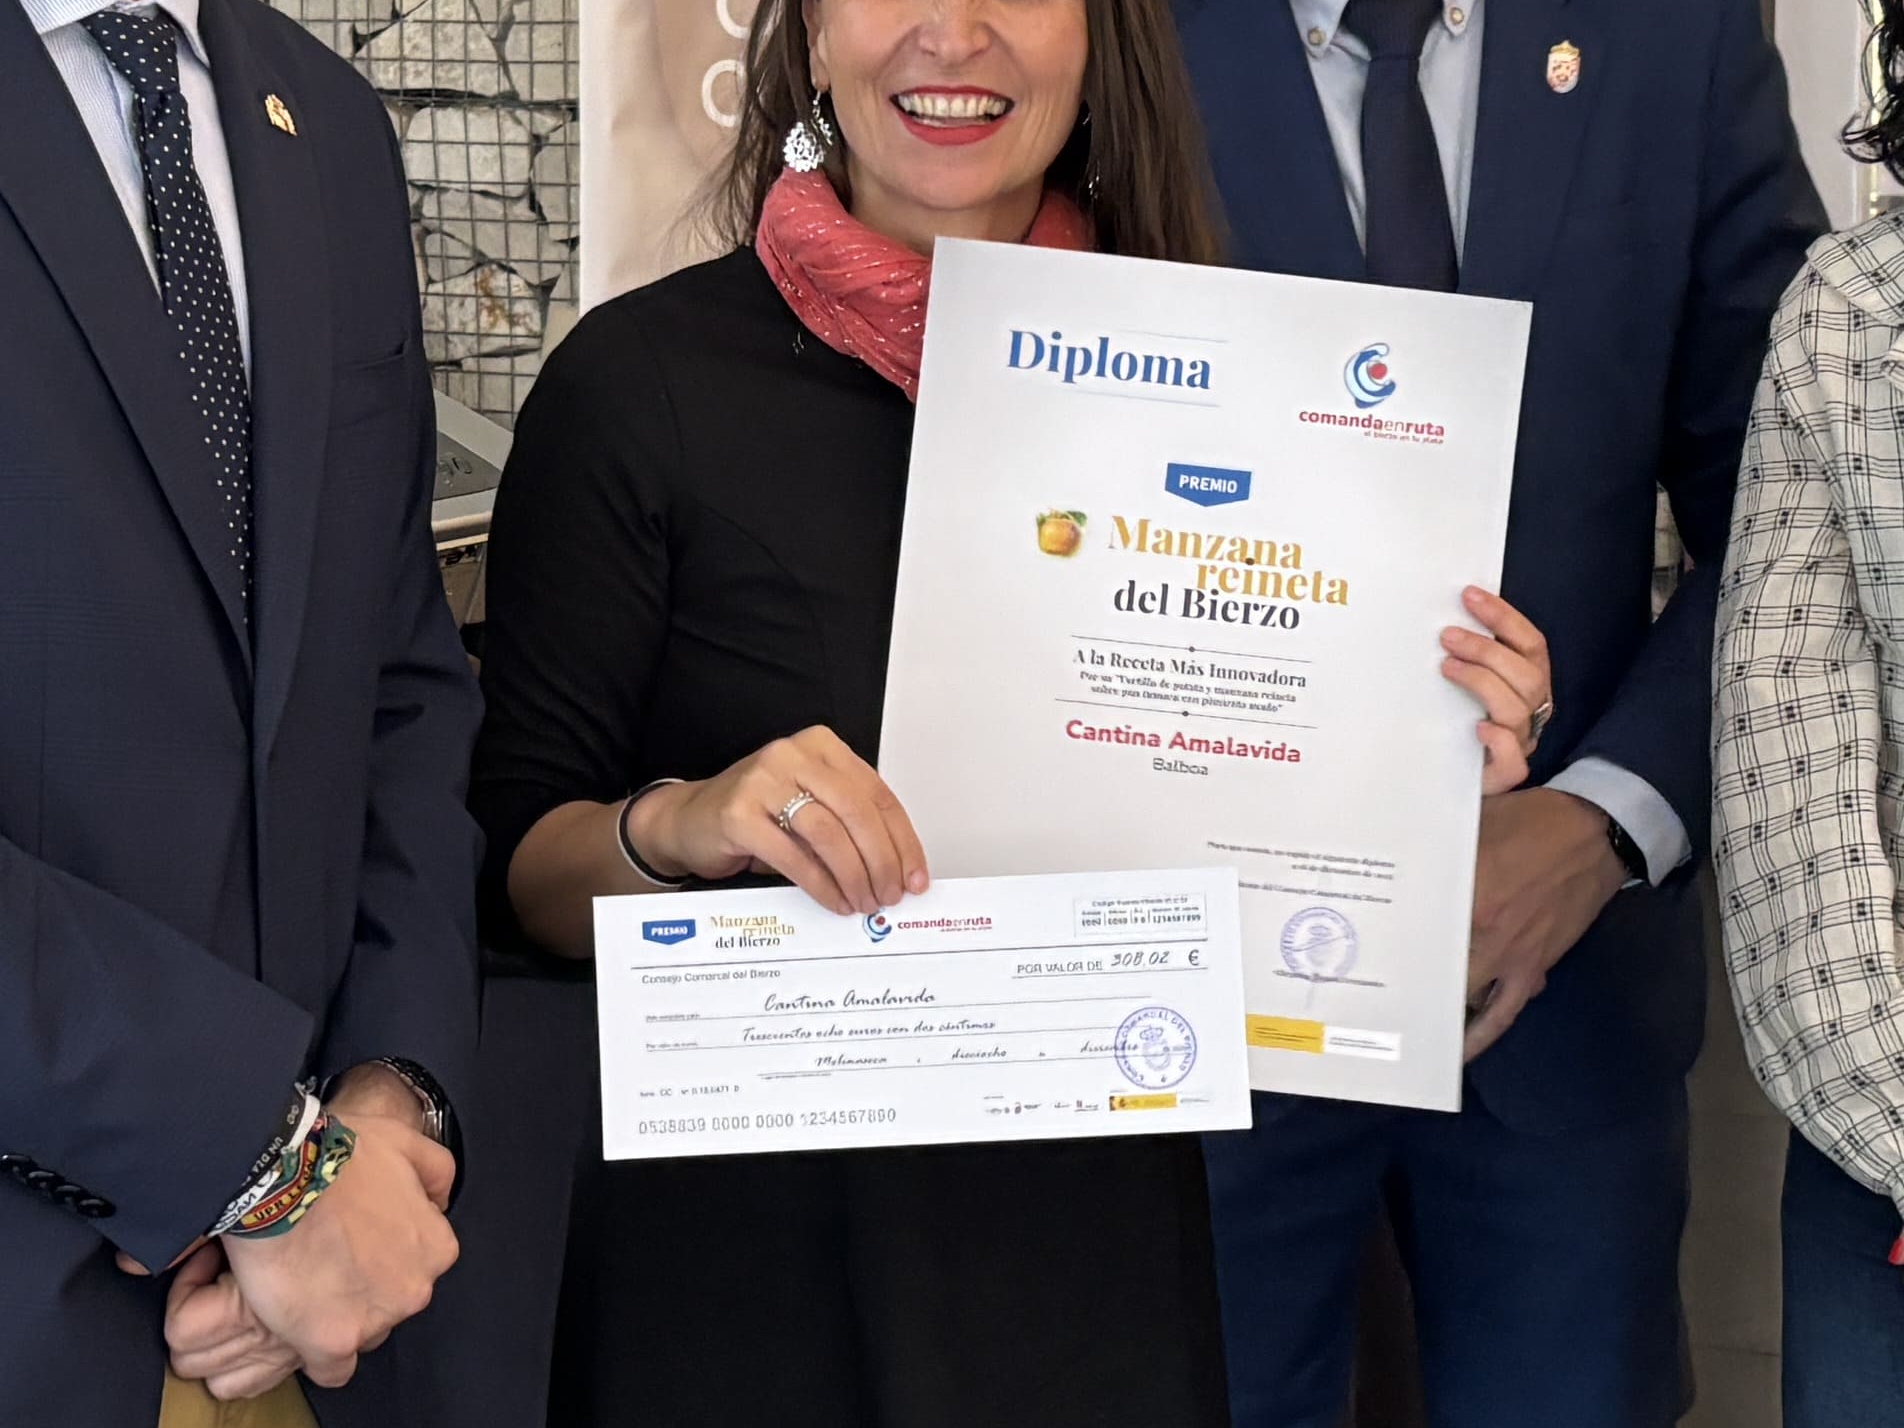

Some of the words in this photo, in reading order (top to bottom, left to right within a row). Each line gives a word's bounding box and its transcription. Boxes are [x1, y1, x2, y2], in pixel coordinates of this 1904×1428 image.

[1006, 329, 1211, 389] Diploma
[1299, 410, 1445, 437] comandaenruta
[1179, 474, 1238, 494] PREMIO
[1108, 515, 1302, 569] Manzana
[1196, 558, 1349, 605] reineta
[1114, 580, 1169, 616] del
[1182, 588, 1300, 630] Bierzo
[1091, 649, 1104, 666] la
[1111, 653, 1165, 673] Receta
[1170, 659, 1205, 678] Más
[1210, 664, 1307, 687] Innovadora
[1066, 719, 1160, 747] Cantina
[1168, 732, 1301, 763] Amalavida
[1153, 757, 1209, 776] Balboa
[710, 915, 777, 928] Manzana
[897, 916, 992, 929] comandaenruta
[715, 936, 734, 948] del
[739, 936, 781, 948] Bierzo
[1017, 963, 1042, 974] POR
[1045, 962, 1083, 973] VALOR
[1087, 960, 1103, 971] DE
[1188, 949, 1200, 966] €
[765, 993, 836, 1011] Cantina
[843, 987, 935, 1008] Amalavida
